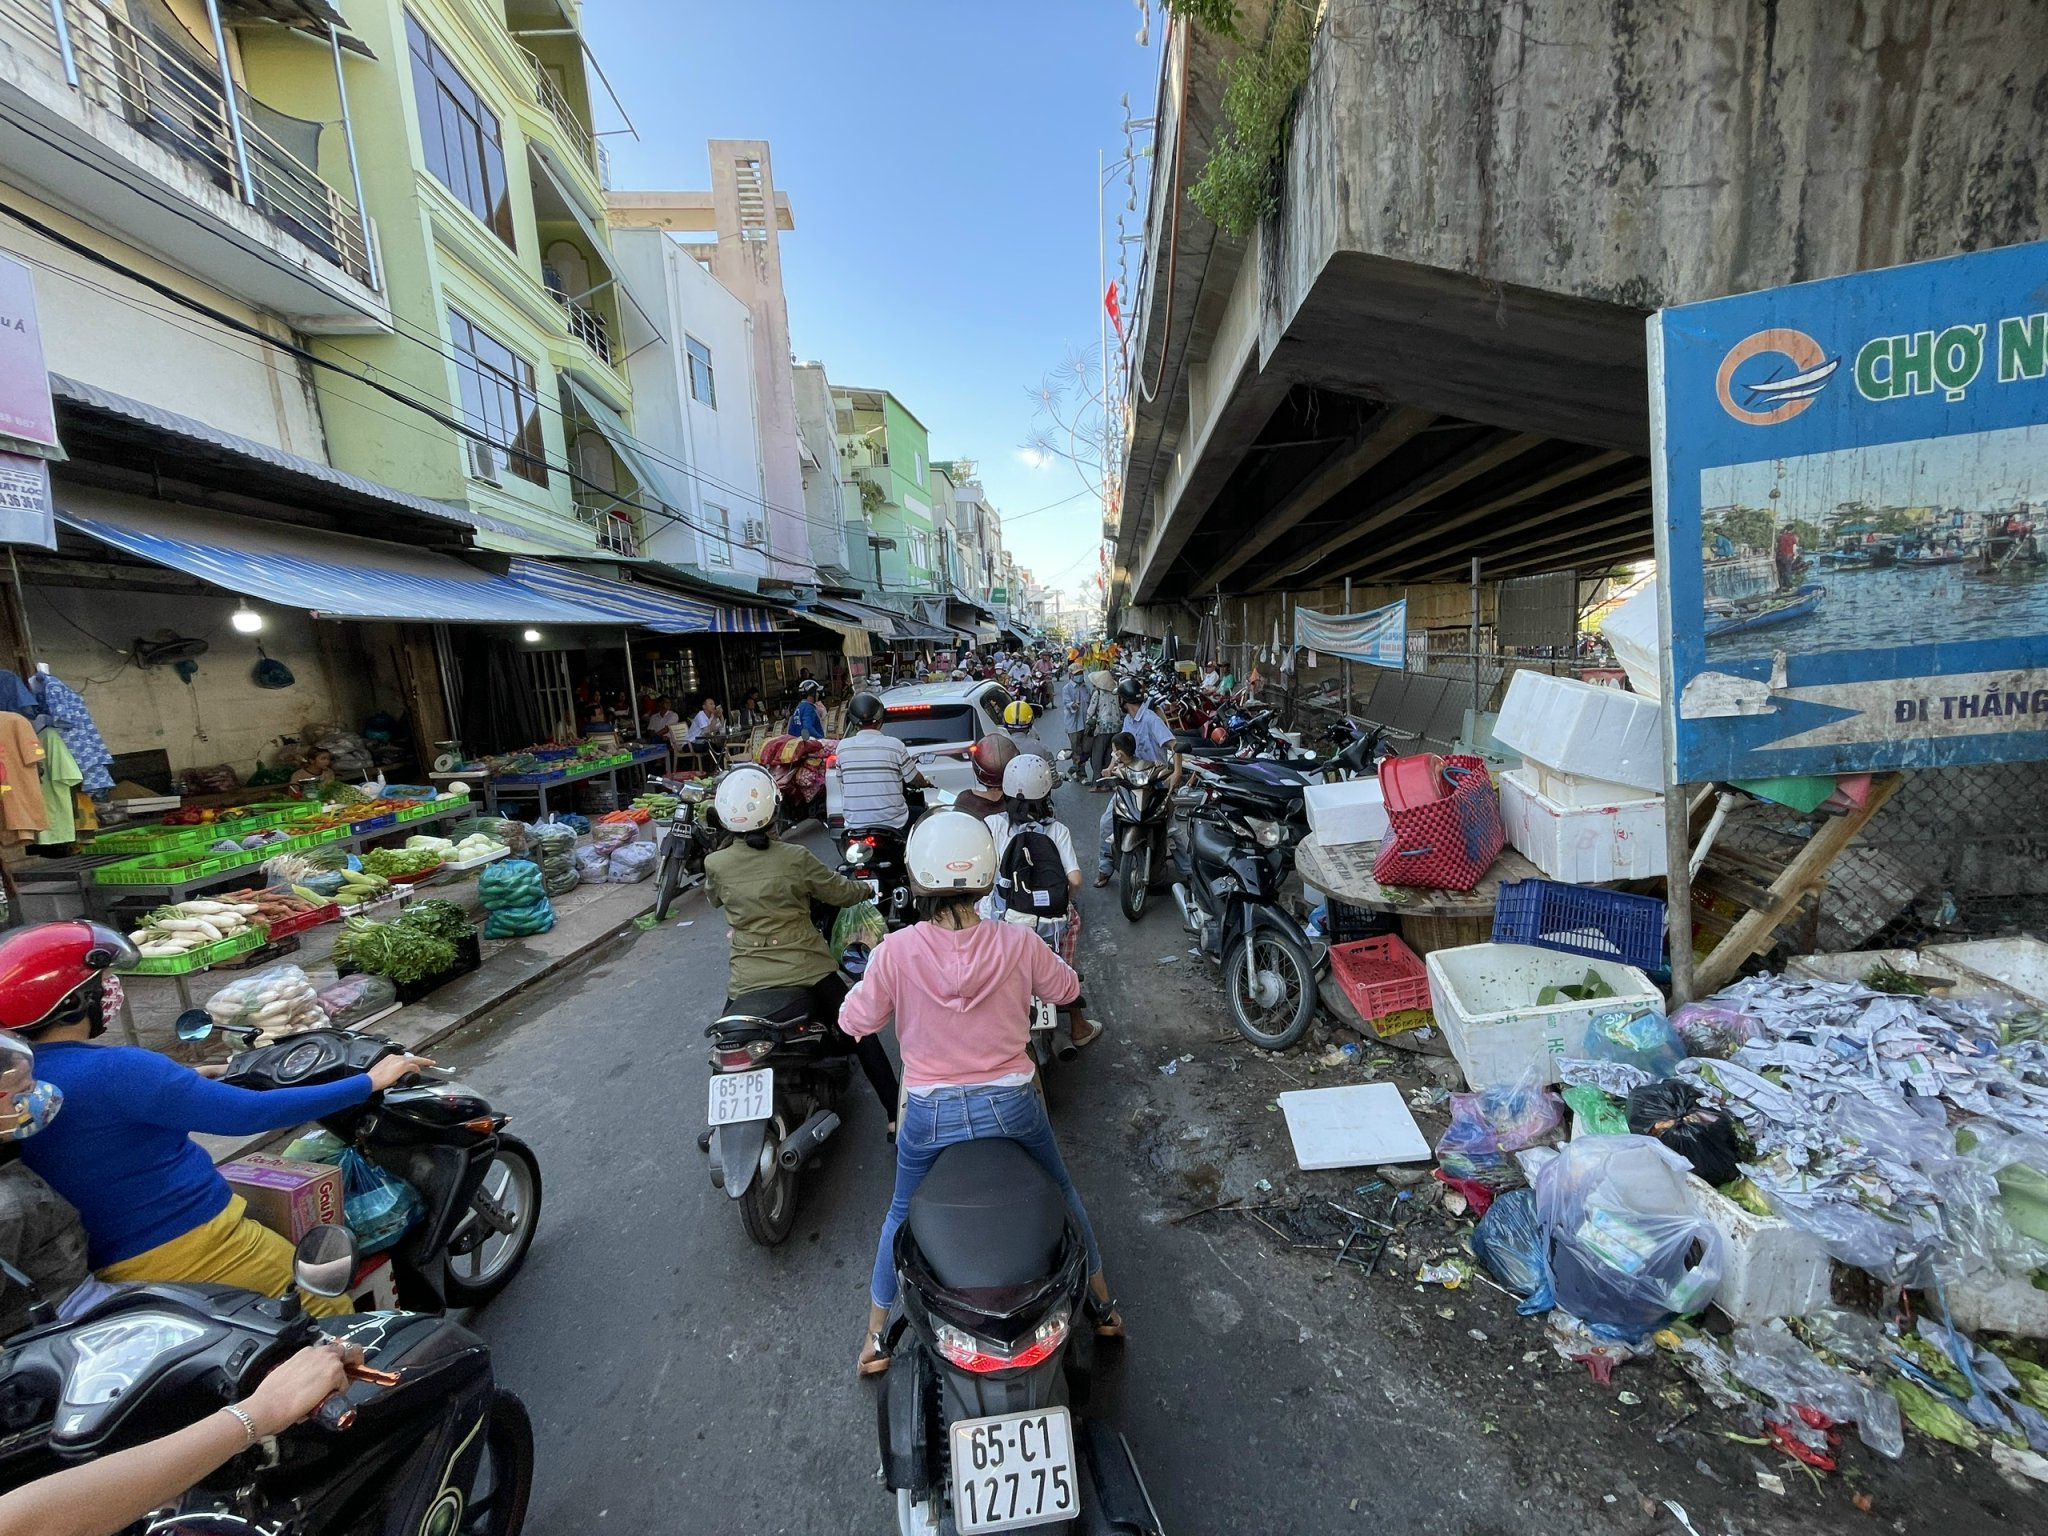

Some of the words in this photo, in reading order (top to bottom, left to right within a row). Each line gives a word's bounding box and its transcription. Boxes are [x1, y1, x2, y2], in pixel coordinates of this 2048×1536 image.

[1855, 323, 1987, 402] CHỢ
[1998, 312, 2048, 383] N
[1895, 696, 1929, 724] ĐI
[719, 1073, 764, 1098] 65-P6
[718, 1094, 763, 1120] 6717
[971, 1416, 1052, 1470] 65-C1
[964, 1464, 1070, 1524] 127.75
